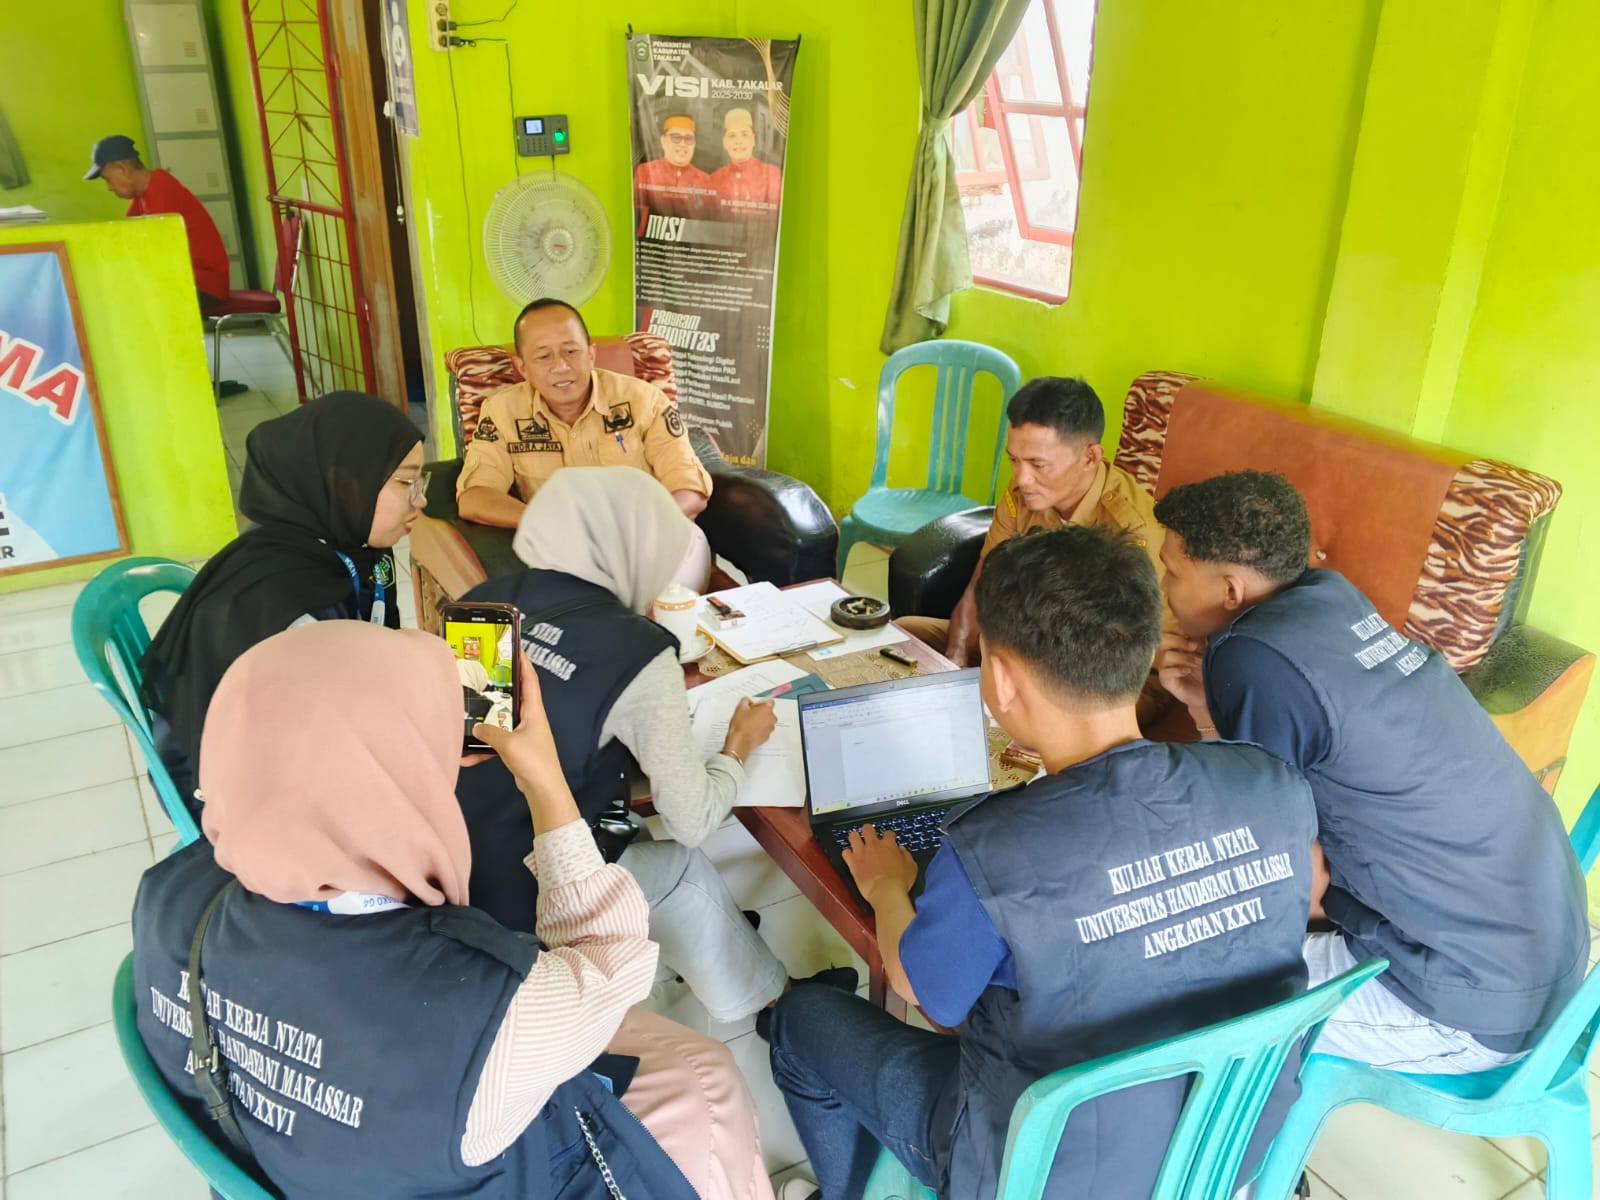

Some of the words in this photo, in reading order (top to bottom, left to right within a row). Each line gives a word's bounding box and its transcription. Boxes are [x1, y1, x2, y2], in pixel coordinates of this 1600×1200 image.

[637, 73, 709, 98] VISI
[711, 79, 735, 88] KAB.
[736, 80, 783, 91] TAKALAR
[511, 443, 537, 452] INDRA
[1107, 853, 1167, 895] KULIAH
[1165, 841, 1213, 877] KERJA
[1212, 826, 1260, 861] NYATA
[1075, 895, 1168, 944] UNIVERSITAS
[1165, 870, 1237, 915] HANDAYANI
[1232, 853, 1294, 892] MAKASSAR
[1144, 911, 1226, 959] ANGKATAN
[1221, 897, 1266, 933] XXVI
[224, 999, 269, 1046] KERJA
[273, 1021, 323, 1069] NYATA
[218, 1029, 280, 1090] HANDAYANI
[281, 1065, 364, 1128] MAKASSAR
[252, 1091, 297, 1136] XXVI
